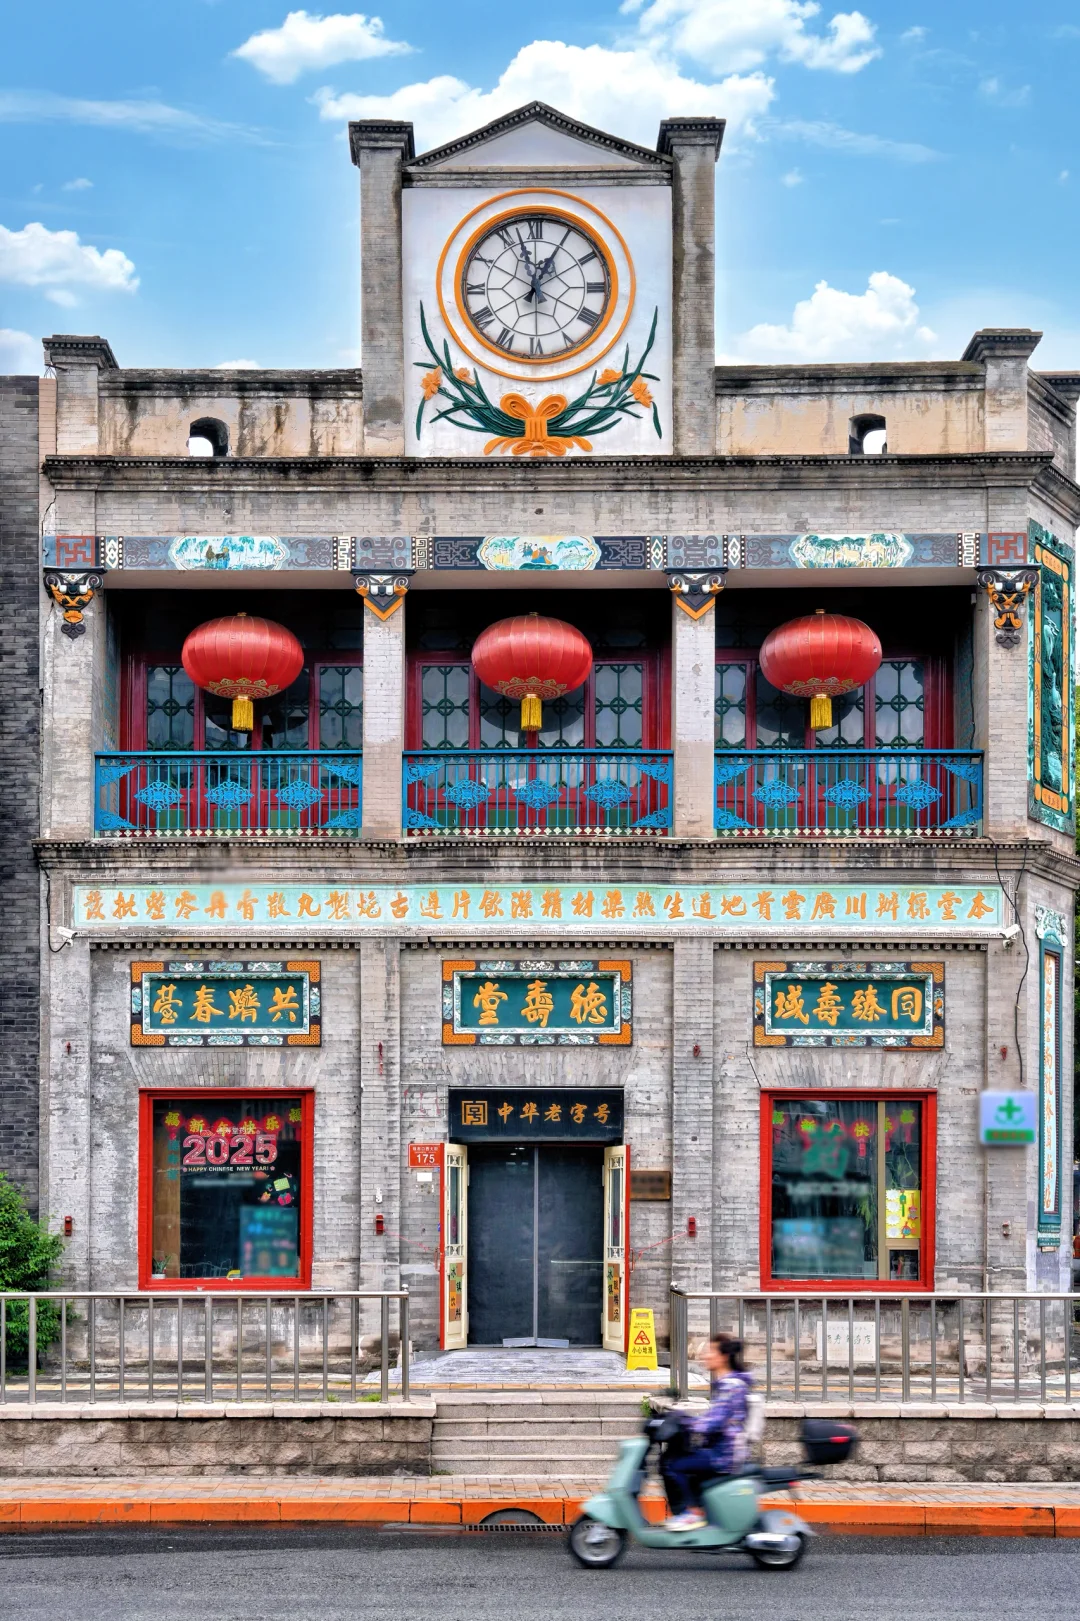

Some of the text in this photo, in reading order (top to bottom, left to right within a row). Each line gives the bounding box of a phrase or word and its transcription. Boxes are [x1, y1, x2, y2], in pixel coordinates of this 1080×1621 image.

[497, 1102, 611, 1124] 中华老字号
[182, 1134, 278, 1166] 2025
[416, 1153, 435, 1164] 175
[631, 1346, 653, 1354] 小心地滑
